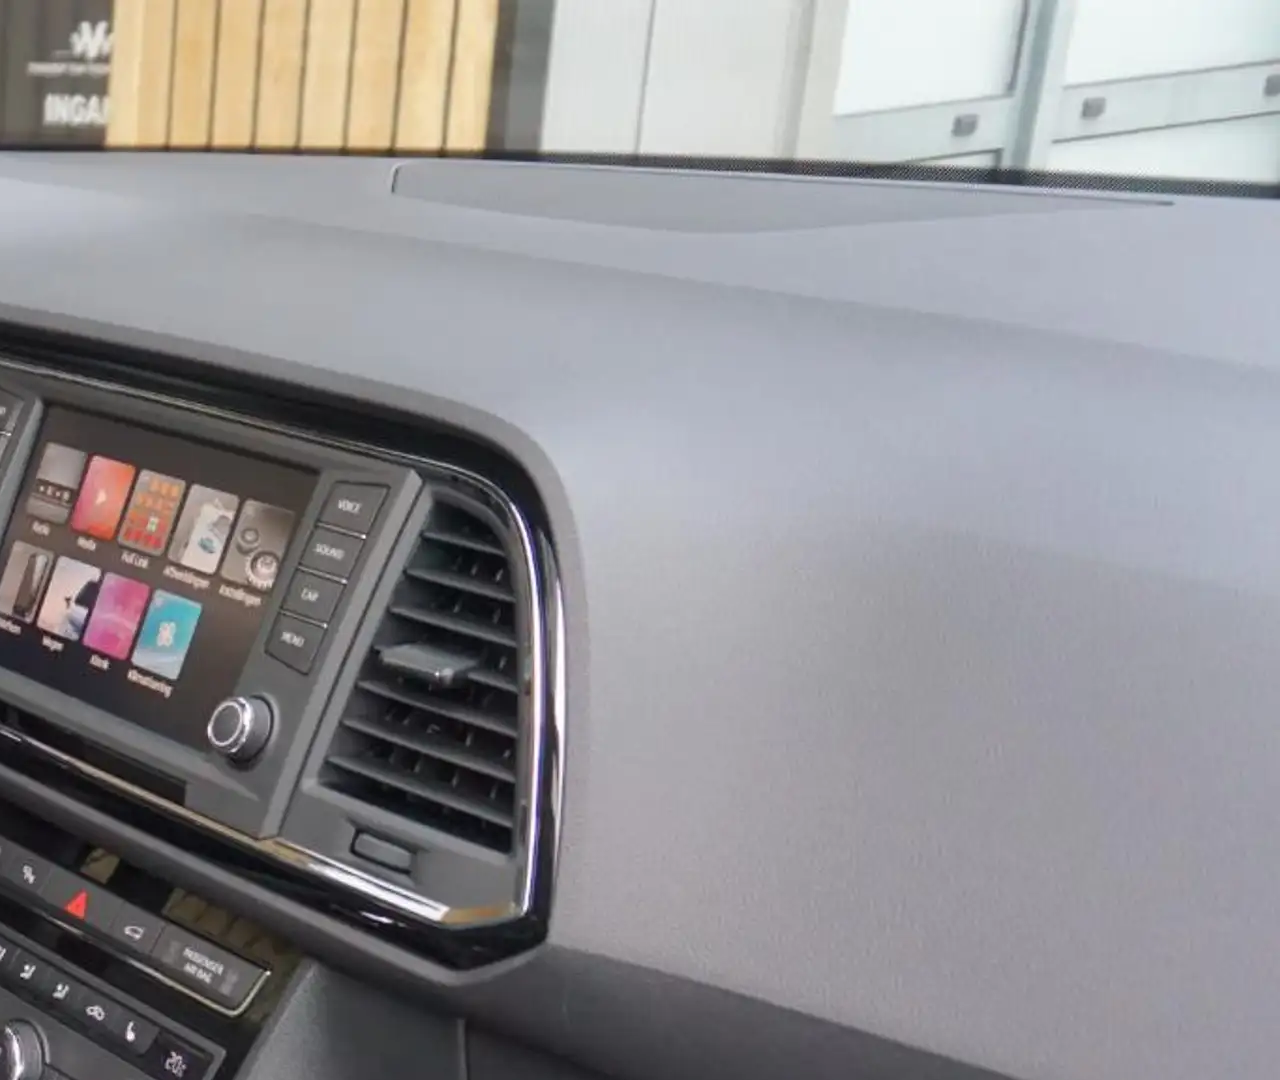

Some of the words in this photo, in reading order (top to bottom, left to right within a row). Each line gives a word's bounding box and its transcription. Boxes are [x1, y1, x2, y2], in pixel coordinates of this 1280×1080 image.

[337, 499, 362, 514] VOICE
[300, 588, 320, 602] CAR
[280, 631, 306, 648] MENU
